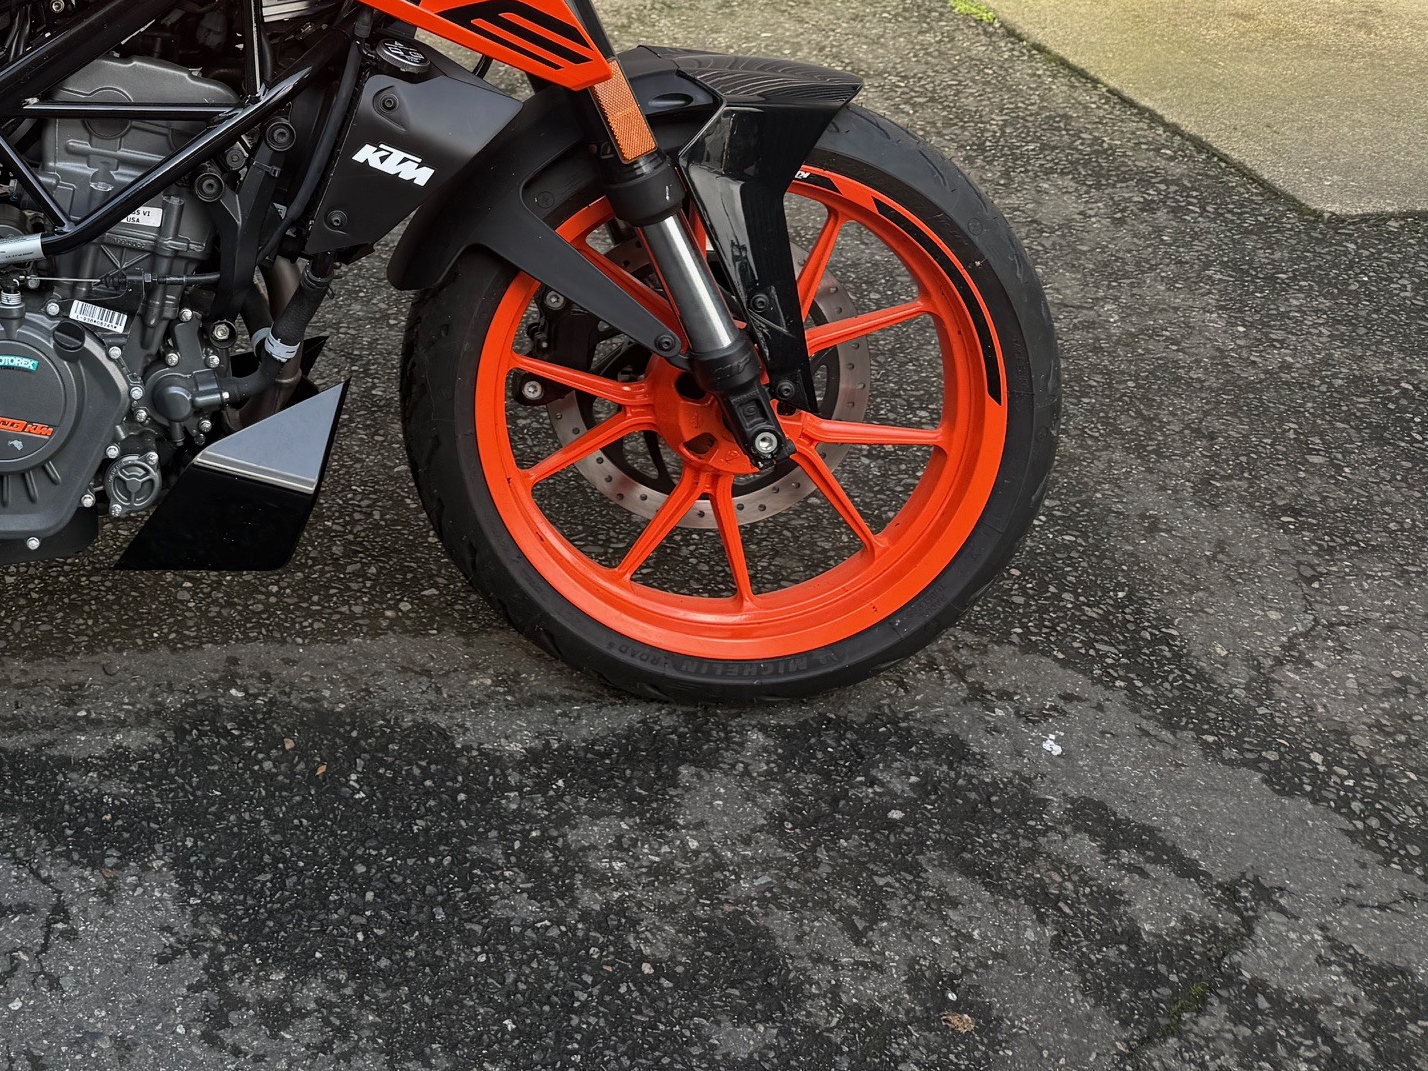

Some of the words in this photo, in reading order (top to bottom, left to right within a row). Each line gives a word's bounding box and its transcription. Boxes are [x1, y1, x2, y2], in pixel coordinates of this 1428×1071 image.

[352, 143, 435, 187] KTM
[24, 422, 54, 436] KTM
[616, 642, 661, 666] ROAD
[680, 656, 807, 677] MICHELIN
